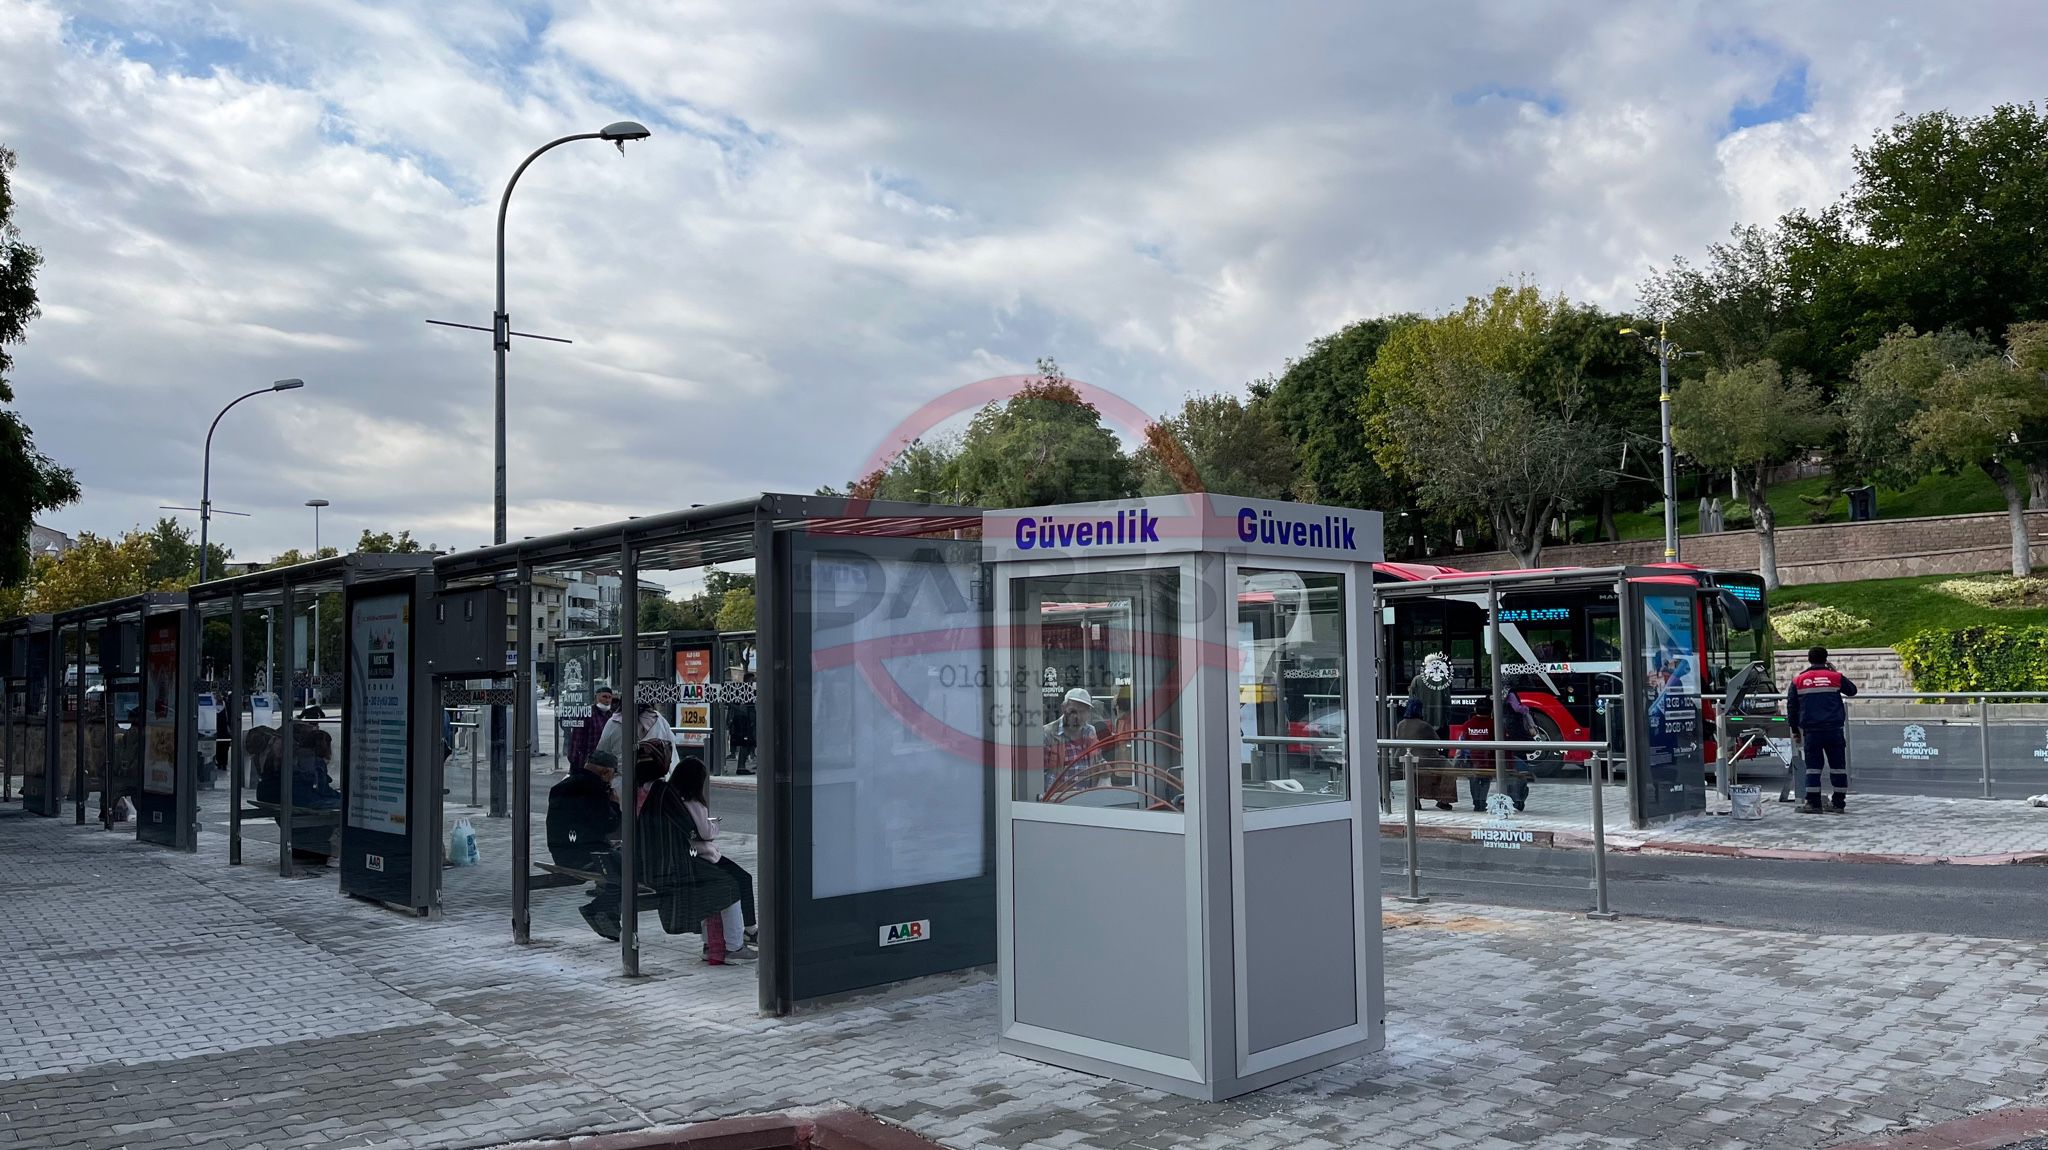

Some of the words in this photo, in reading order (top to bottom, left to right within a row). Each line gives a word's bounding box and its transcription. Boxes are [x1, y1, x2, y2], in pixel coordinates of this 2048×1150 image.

[1016, 508, 1159, 549] Güvenlik
[1238, 498, 1356, 549] Güvenlik
[1549, 663, 1568, 671] AAR
[684, 686, 703, 699] AAR
[1671, 698, 1680, 707] GB
[1673, 722, 1681, 733] GB
[888, 922, 922, 941] AAR
